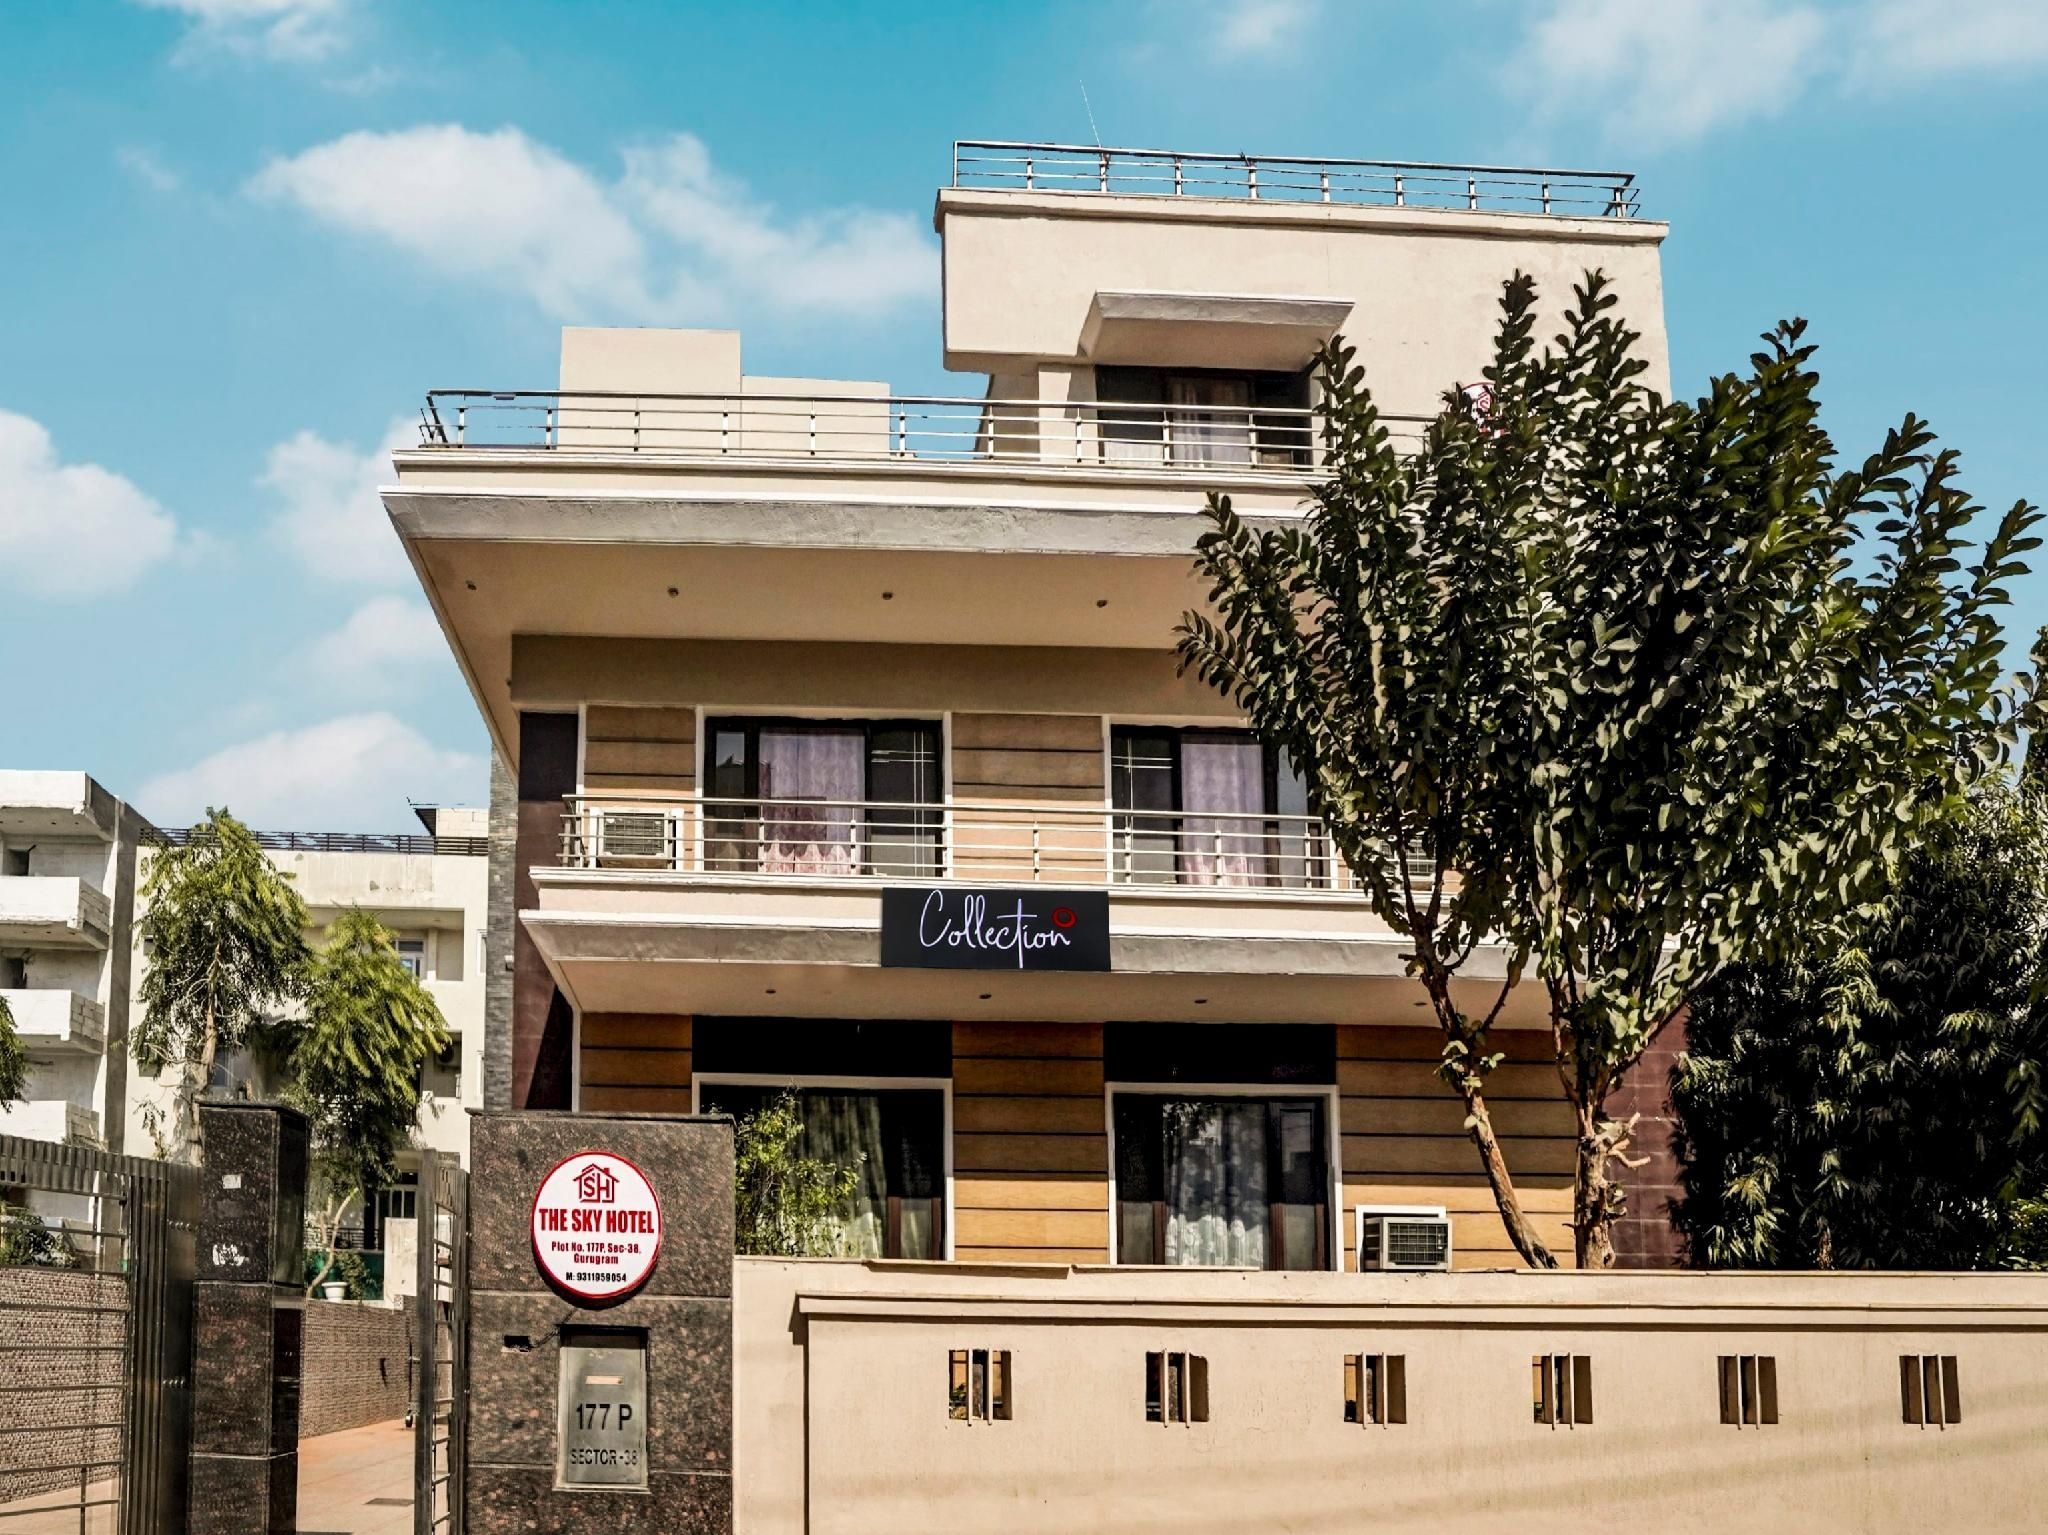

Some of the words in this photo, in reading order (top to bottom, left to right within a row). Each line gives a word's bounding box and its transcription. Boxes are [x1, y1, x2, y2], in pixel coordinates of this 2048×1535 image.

[919, 889, 1071, 969] Collection
[539, 1208, 568, 1232] THE
[571, 1209, 603, 1233] SKY
[606, 1210, 655, 1234] HOTEL
[551, 1240, 569, 1252] Plot
[571, 1241, 585, 1253] No.
[573, 1253, 619, 1265] Gurugram
